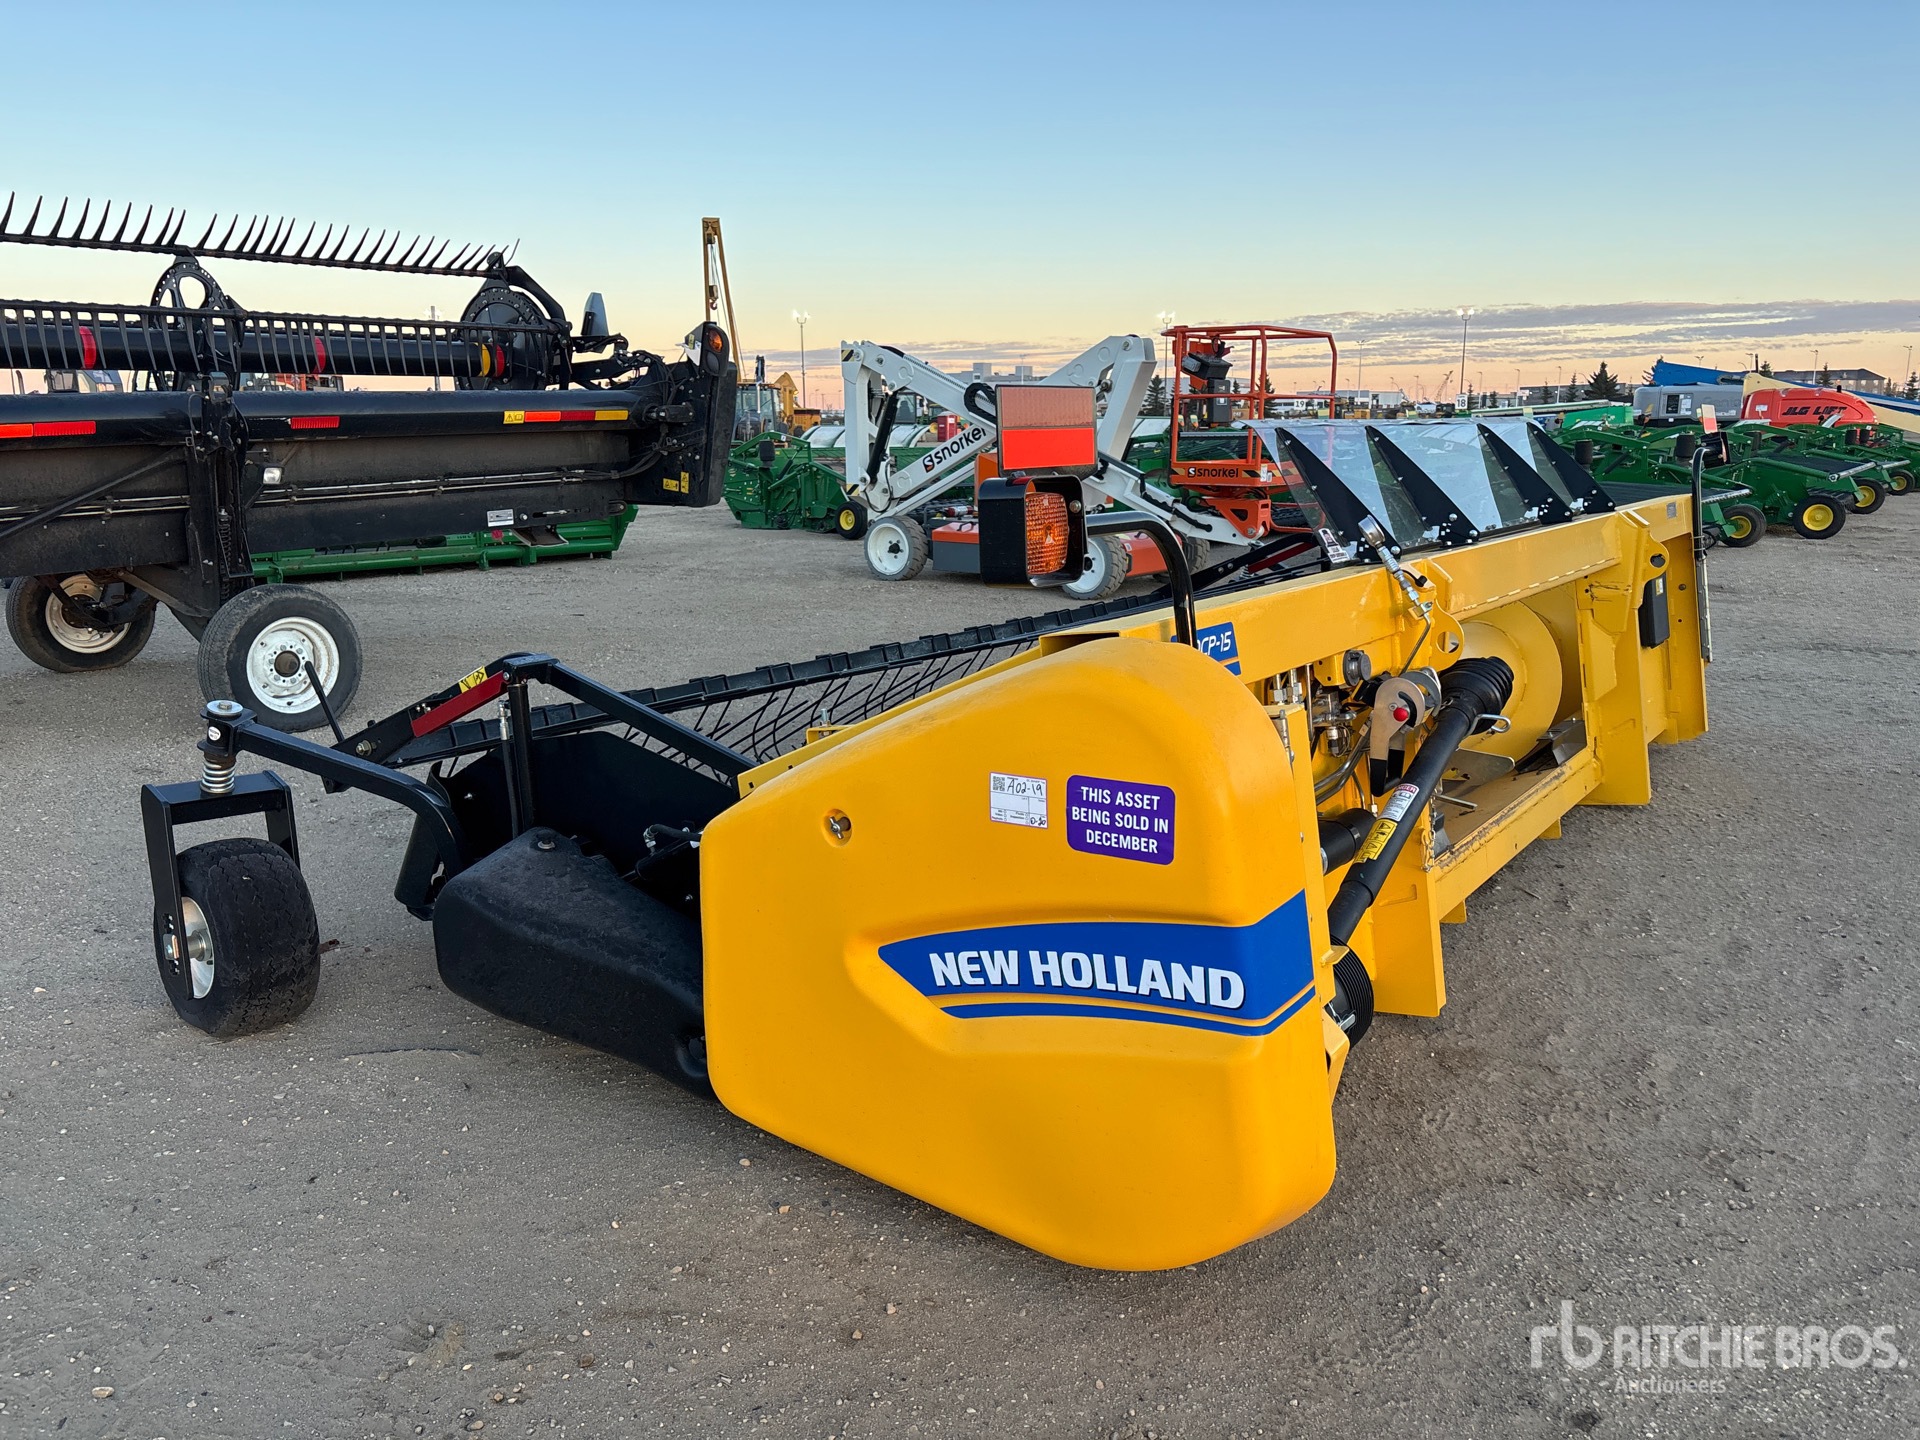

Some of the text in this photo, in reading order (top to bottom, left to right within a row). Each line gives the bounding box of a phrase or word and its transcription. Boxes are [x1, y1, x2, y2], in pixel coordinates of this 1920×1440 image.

[1295, 400, 1304, 408] 19
[1457, 399, 1466, 408] 18
[1782, 406, 1847, 415] JLG LIFT
[1198, 467, 1239, 478] snorkel
[1081, 786, 1160, 811] THIS ASSET
[1072, 806, 1168, 834] BEING SOLD IN
[1086, 829, 1158, 853] DECEMBER
[929, 950, 1245, 1010] NEW HOLLAND
